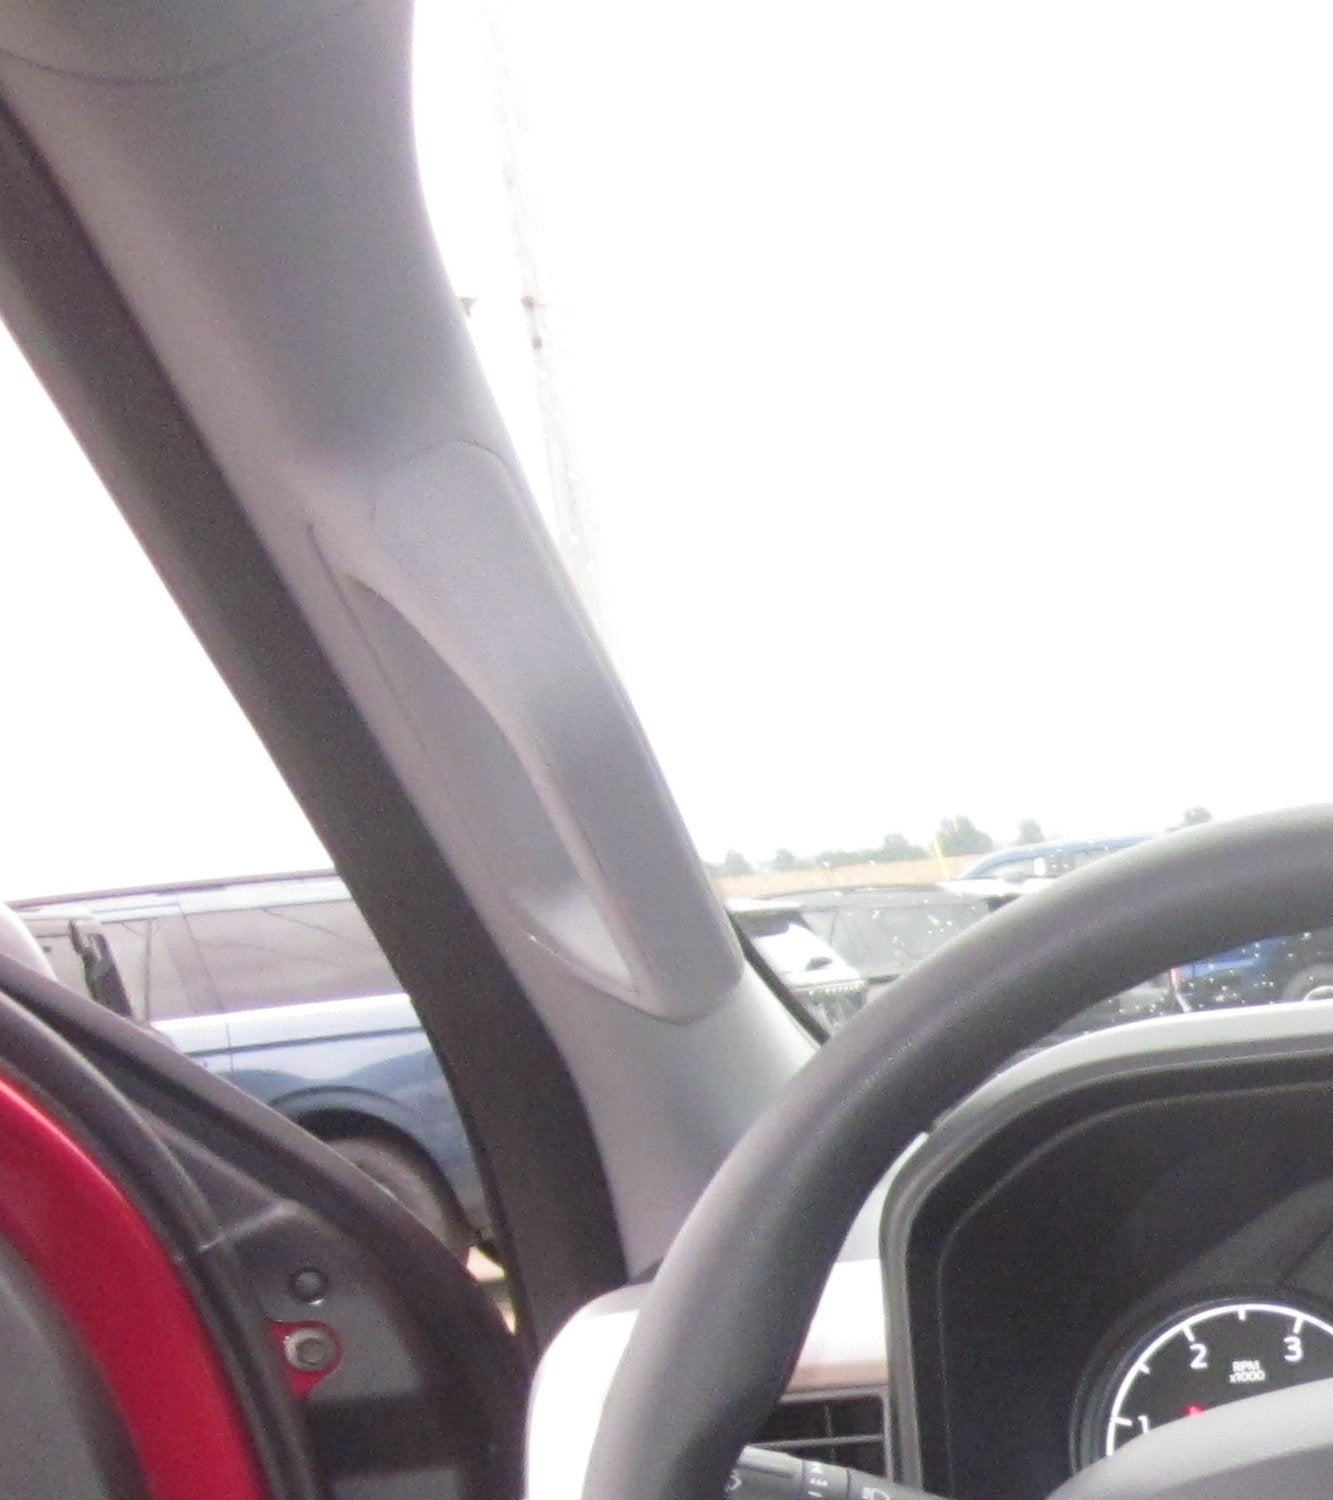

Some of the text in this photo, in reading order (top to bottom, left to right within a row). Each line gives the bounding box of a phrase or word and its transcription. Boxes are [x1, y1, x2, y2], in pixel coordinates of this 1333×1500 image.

[1189, 1343, 1209, 1369] 2
[1283, 1335, 1304, 1362] 3
[1231, 1360, 1261, 1371] RPM
[1229, 1369, 1266, 1383] x1000
